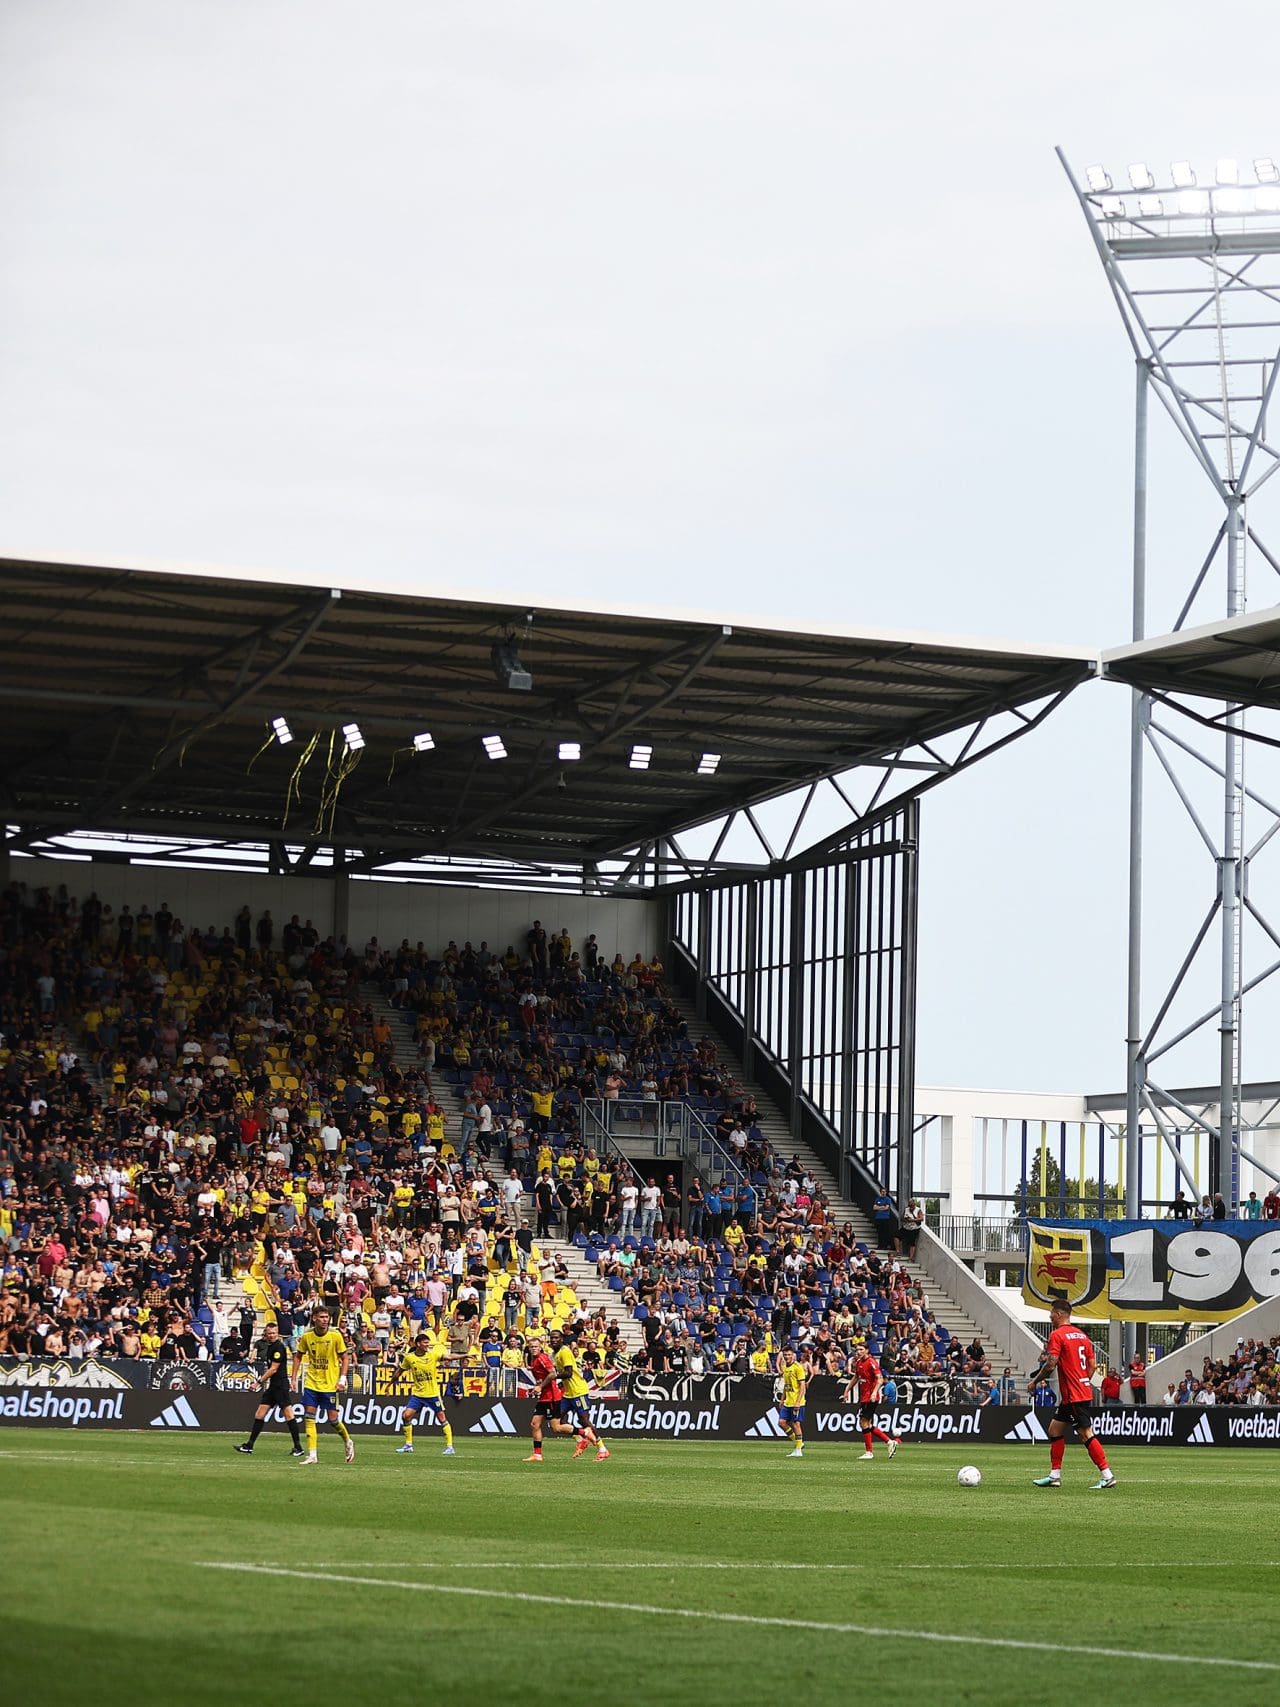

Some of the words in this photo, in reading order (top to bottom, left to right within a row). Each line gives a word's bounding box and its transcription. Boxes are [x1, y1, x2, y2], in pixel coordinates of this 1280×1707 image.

[1078, 1345, 1087, 1370] 5
[227, 1378, 251, 1390] 058
[0, 1390, 124, 1425] alshop.nl
[1074, 1411, 1174, 1442] etbalshop.nl
